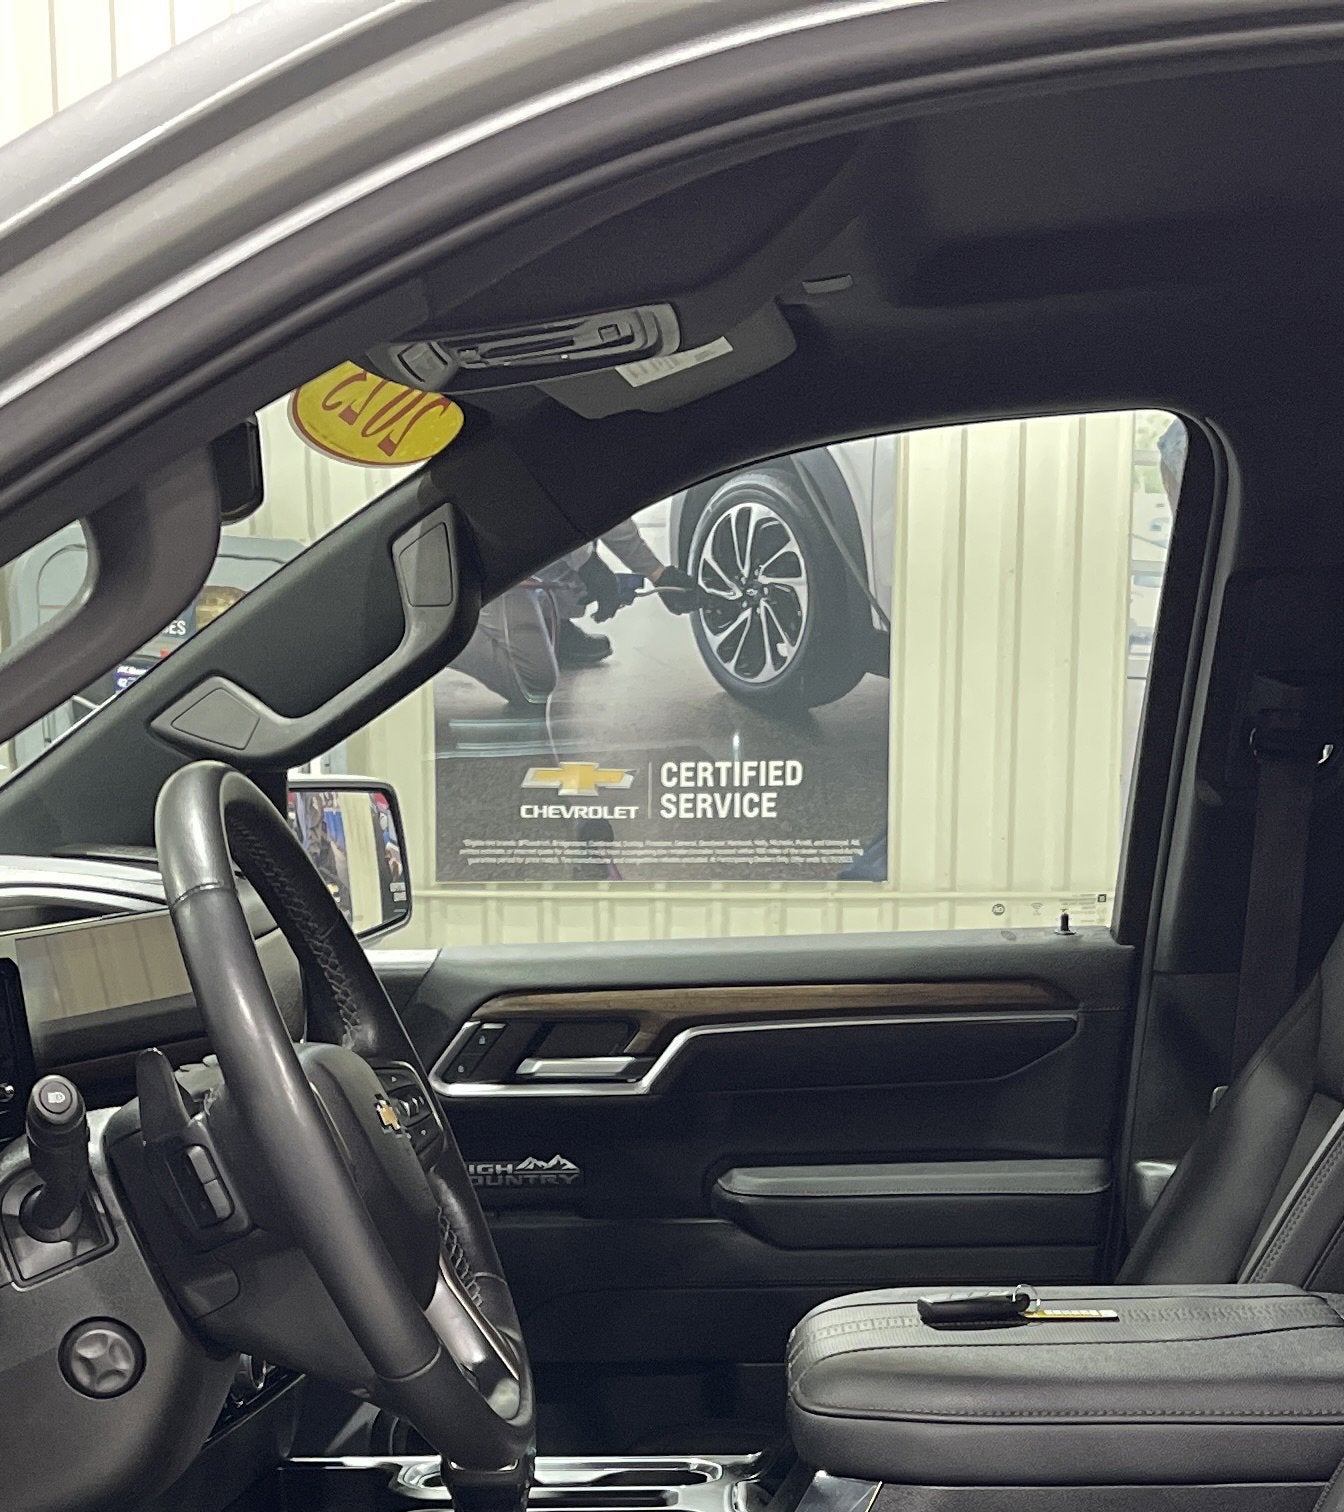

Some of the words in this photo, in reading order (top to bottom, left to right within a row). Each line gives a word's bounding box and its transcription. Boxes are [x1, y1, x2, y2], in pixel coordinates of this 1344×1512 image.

[660, 760, 804, 788] CERTIFIED
[520, 805, 640, 819] CHEVROLET
[659, 792, 779, 819] SERVICE
[468, 1164, 514, 1175] IGH
[470, 1174, 580, 1186] OUNTRY
